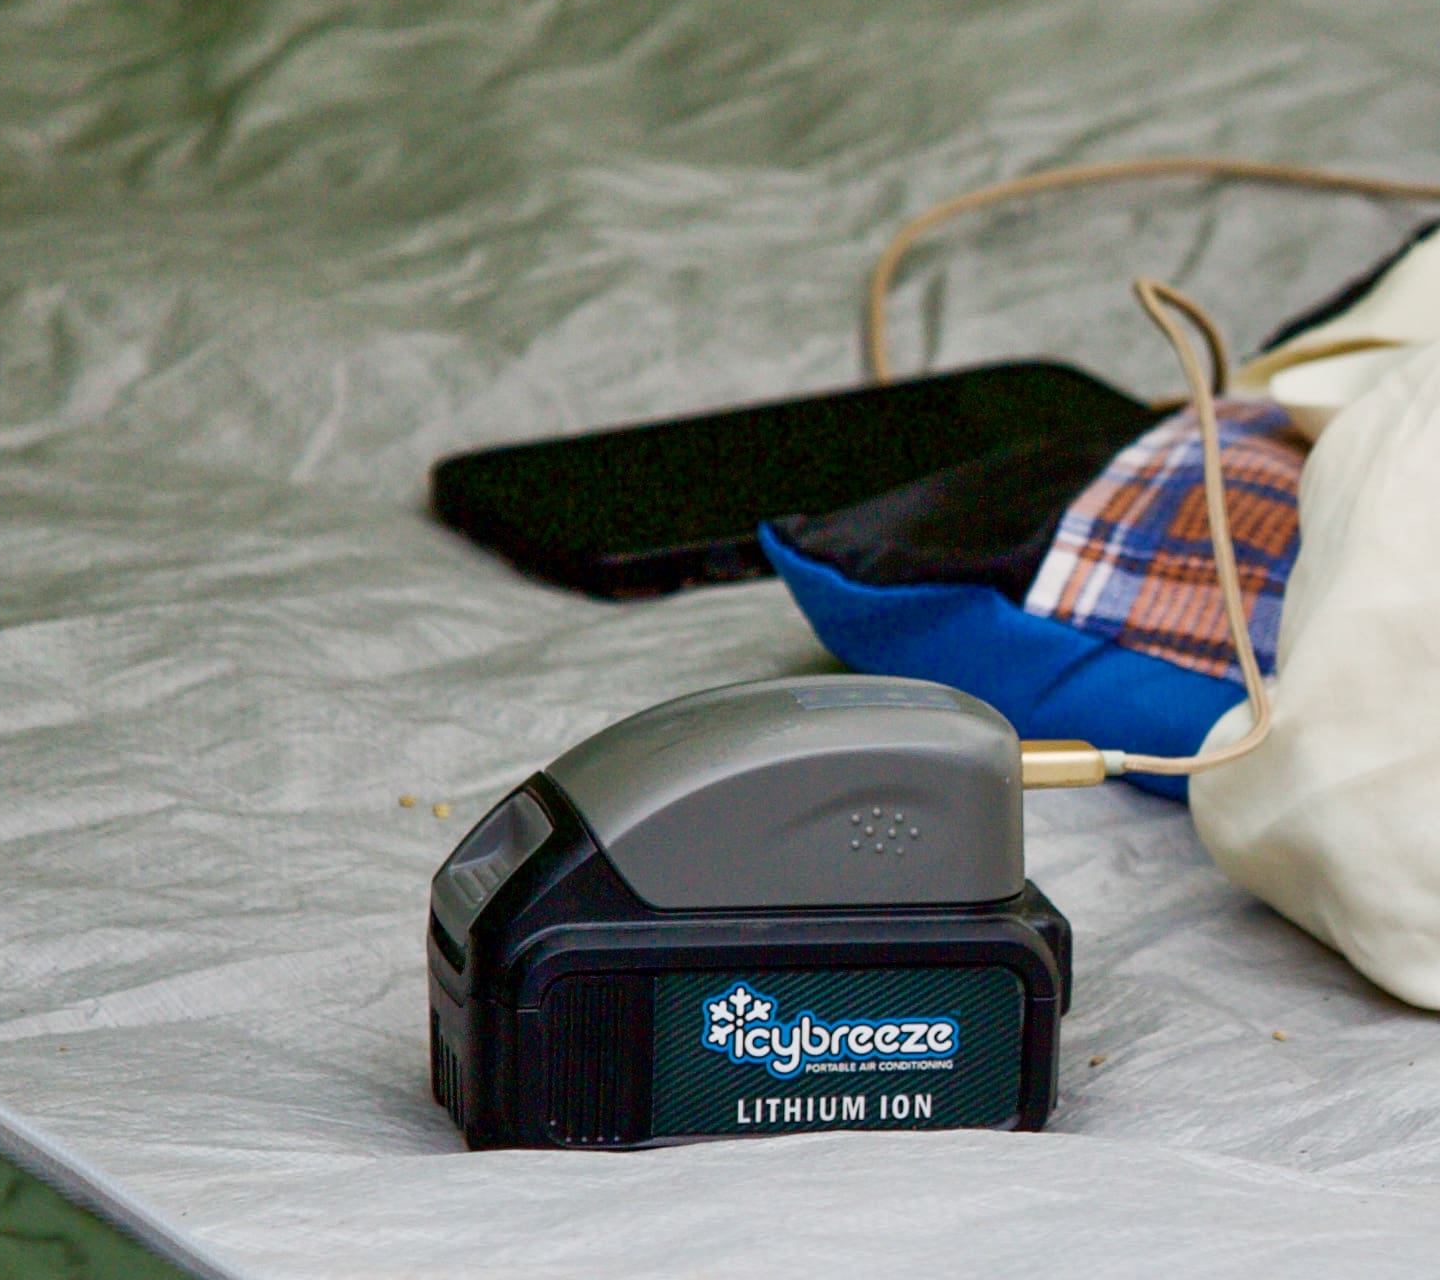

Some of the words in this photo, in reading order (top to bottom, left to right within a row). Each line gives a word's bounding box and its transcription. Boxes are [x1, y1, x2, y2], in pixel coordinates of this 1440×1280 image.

[734, 1016, 954, 1073] icybreeze
[806, 1062, 856, 1073] PORTABLE
[859, 1062, 876, 1072] AIR
[879, 1059, 954, 1071] CONDITIONING
[738, 1096, 865, 1123] LITHIUM
[880, 1094, 933, 1120] ION
